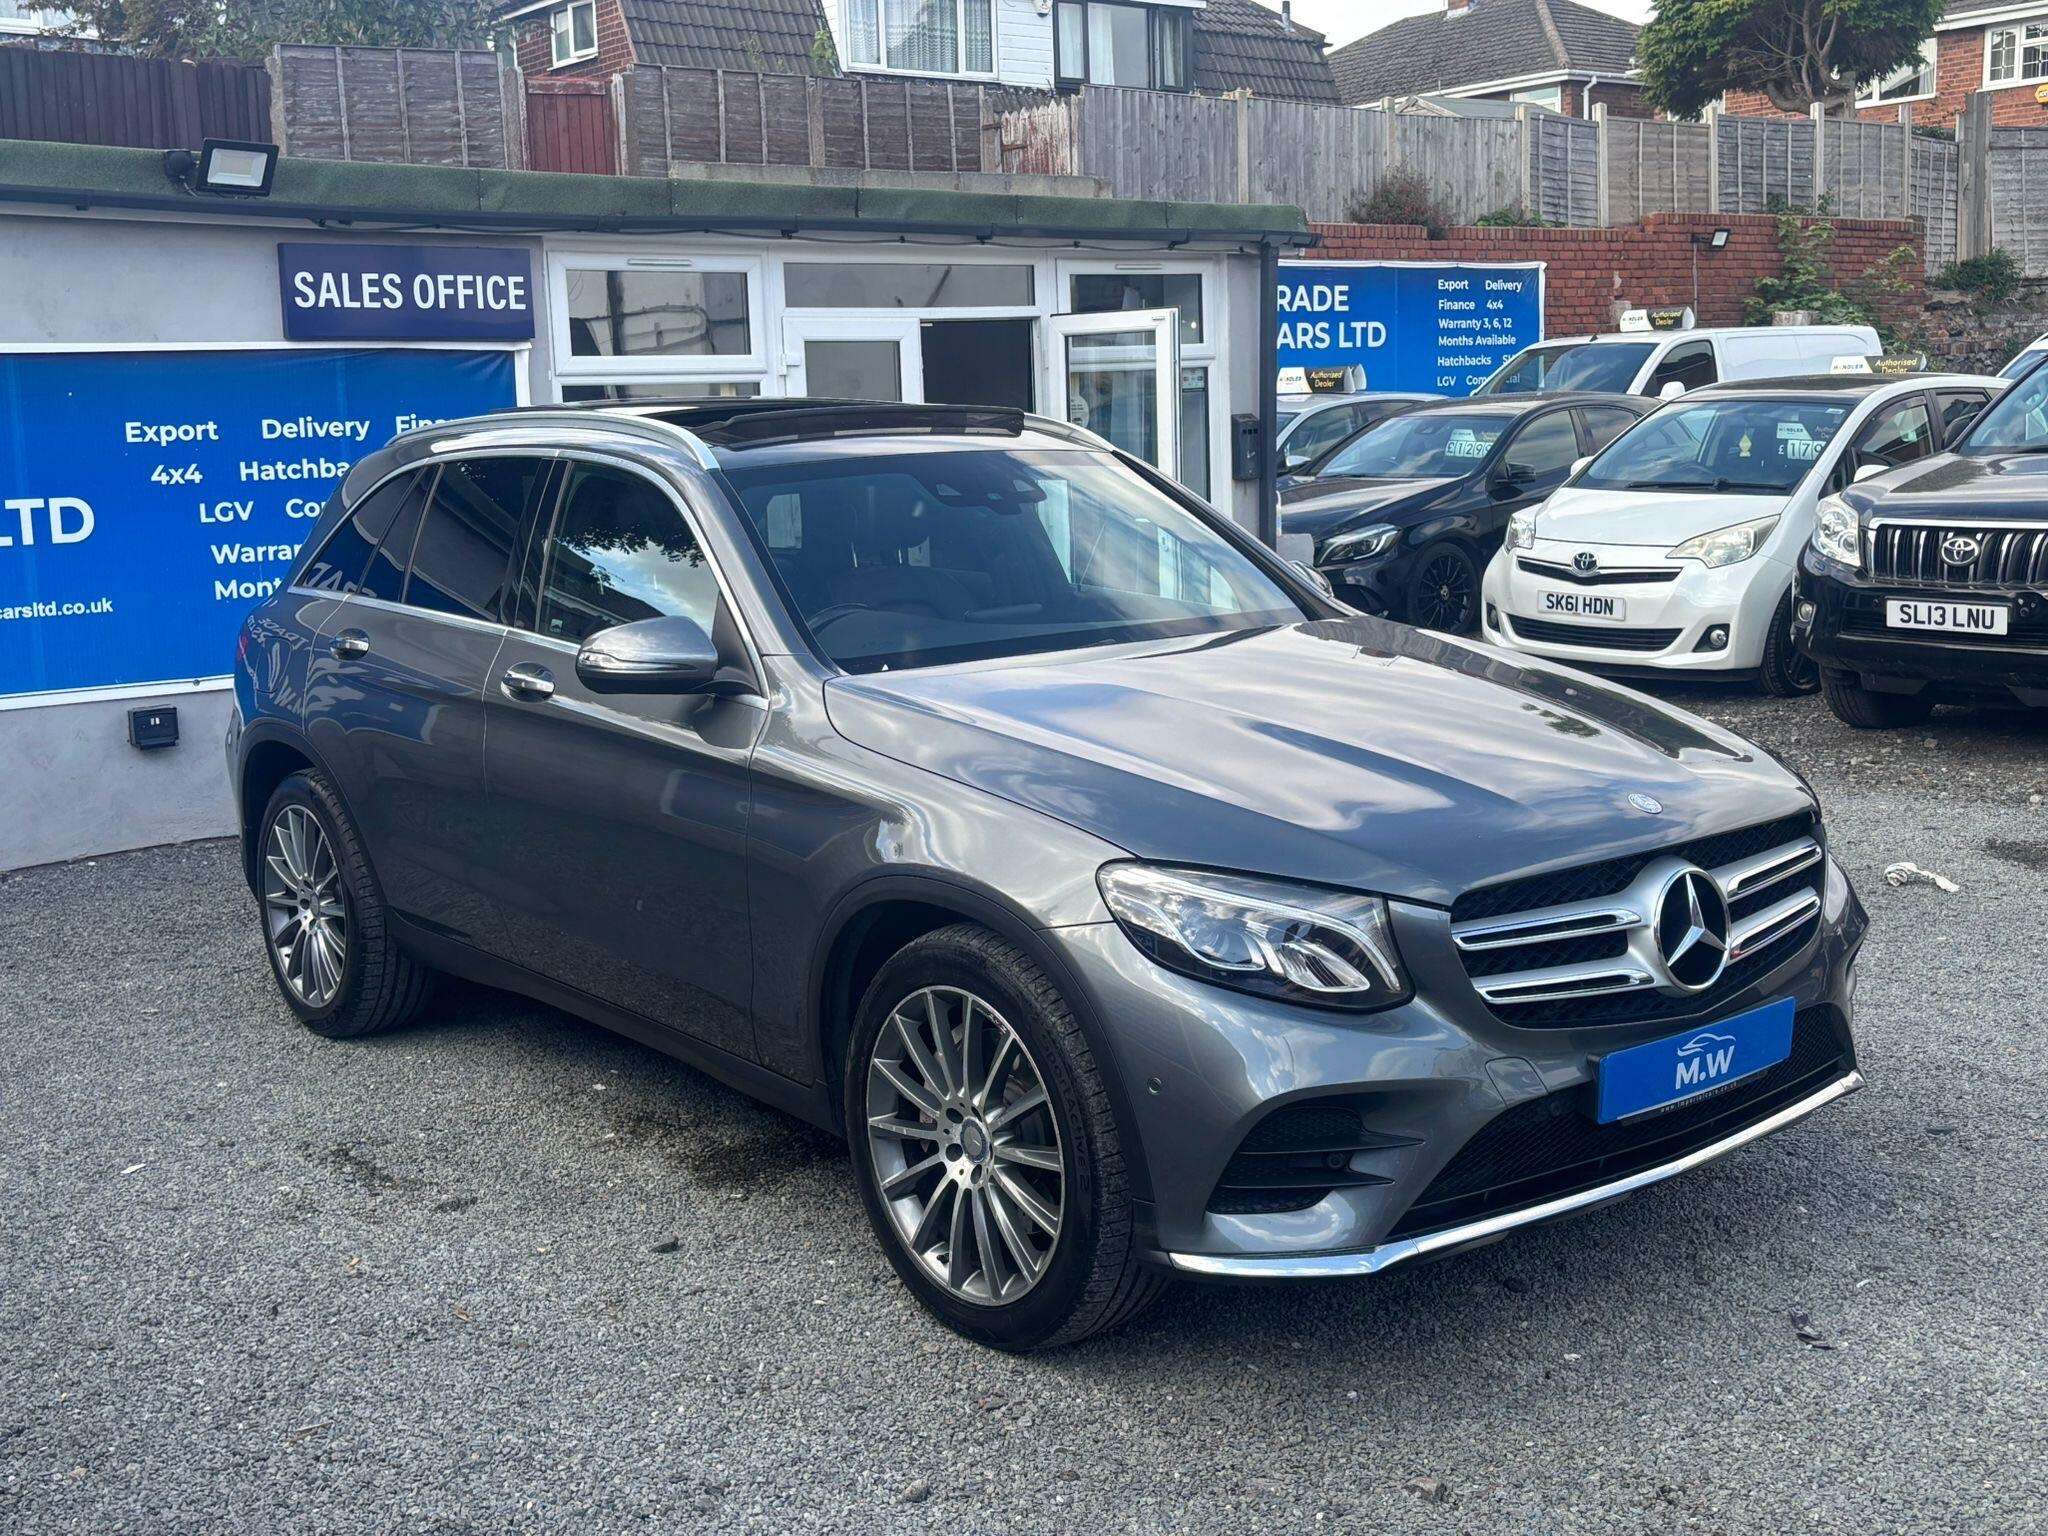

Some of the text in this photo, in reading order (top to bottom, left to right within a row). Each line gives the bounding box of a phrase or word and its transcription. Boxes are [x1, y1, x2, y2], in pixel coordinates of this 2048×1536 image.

[293, 271, 528, 310] SALES OFFICE
[1437, 278, 1522, 292] Export Delivery
[1276, 284, 1350, 312] RADE
[1438, 299, 1504, 310] Finance 4x4
[1276, 321, 1387, 349] ARS LTD
[1438, 317, 1512, 331] Warranty 3, 6, 12
[1438, 334, 1516, 346] Months Available
[1437, 355, 1492, 366] Hatchbacks
[1874, 357, 1918, 367] Authorised
[1314, 379, 1336, 389] Dealer
[1436, 375, 1456, 387] LGV
[124, 420, 219, 446] Export
[261, 416, 370, 441] Delivery
[150, 463, 203, 485] 4x4
[199, 498, 327, 524] LGV Co
[0, 597, 114, 620] arsltd.co.uk
[1546, 593, 1614, 616] SK61 HDN
[1899, 603, 1995, 630] SL13 LNU
